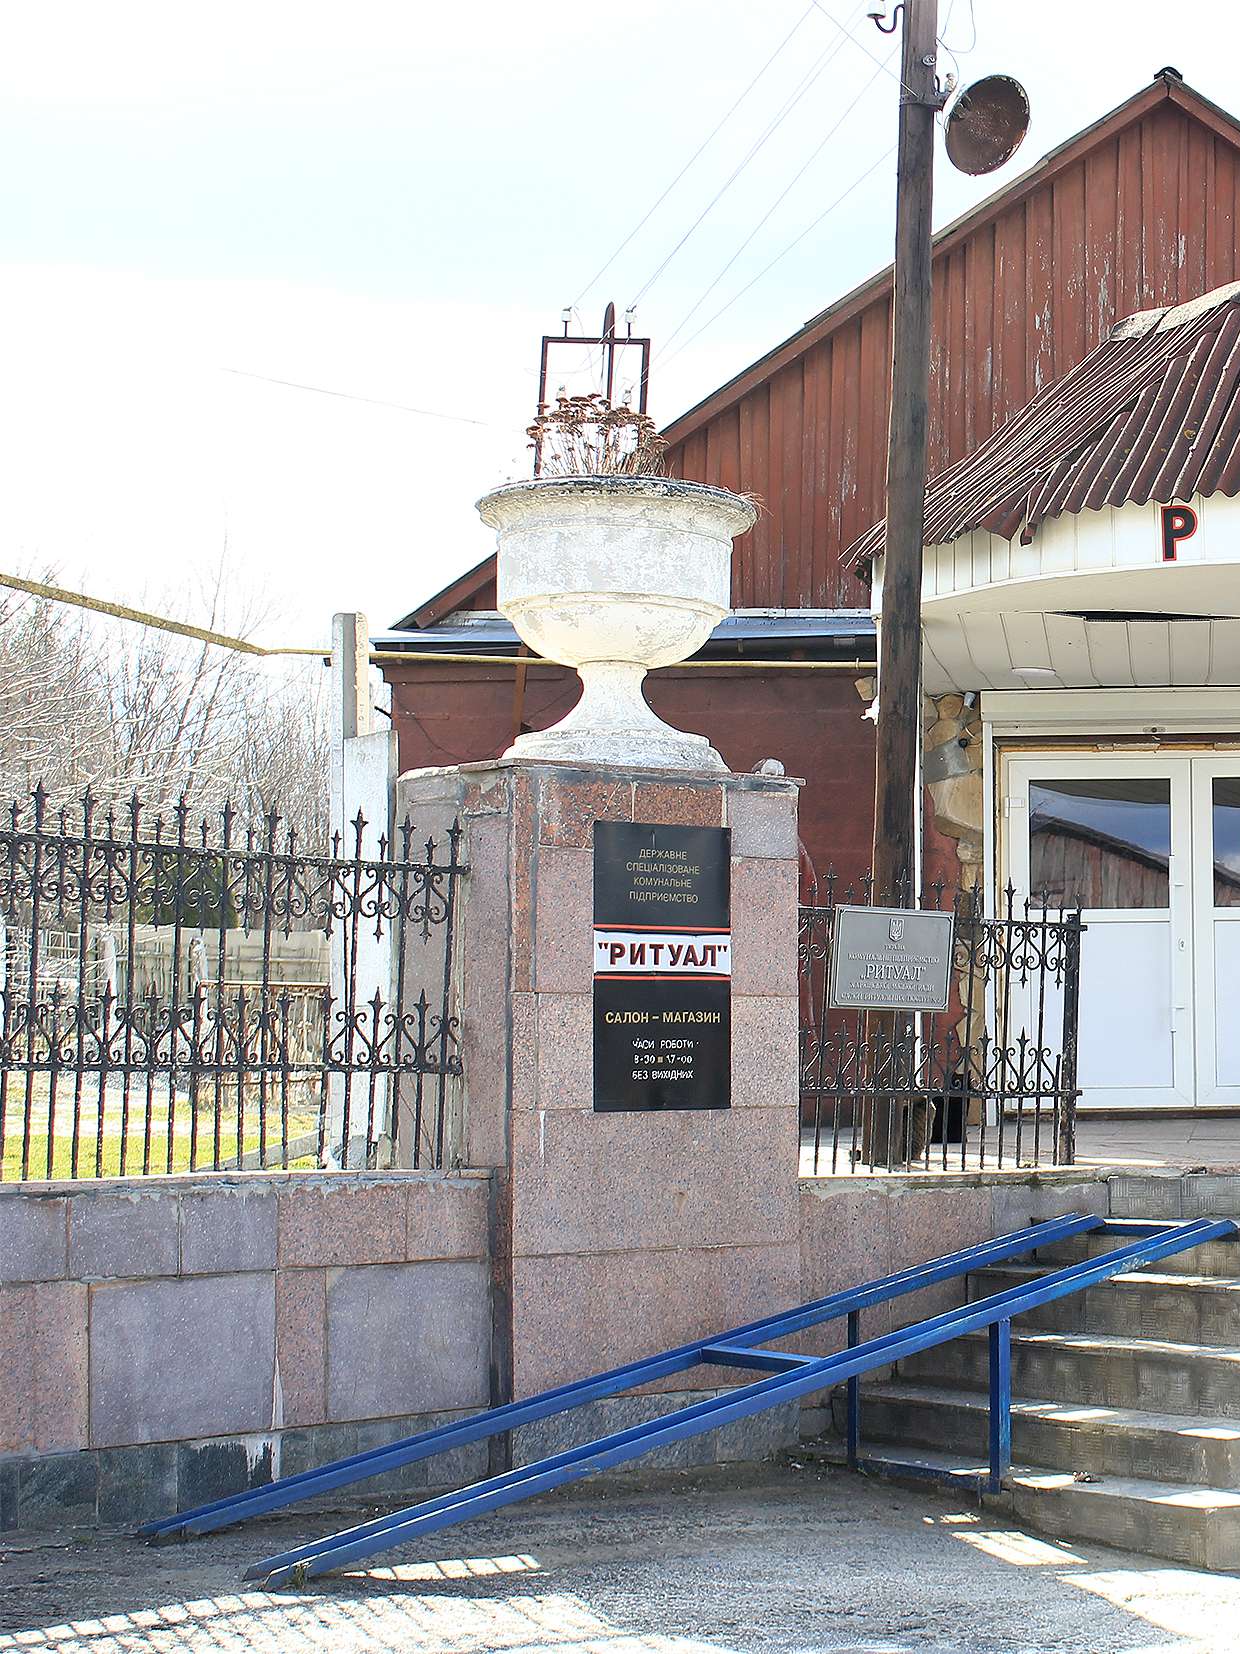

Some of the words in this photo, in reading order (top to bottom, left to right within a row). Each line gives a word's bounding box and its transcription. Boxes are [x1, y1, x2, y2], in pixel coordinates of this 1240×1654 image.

[638, 848, 688, 860] ДЕРЖАВНЕ
[626, 861, 700, 875] СПЕЦІАЛІЗОВАНЕ
[633, 876, 692, 888] КОМУНАЛЬНЕ
[629, 890, 699, 904] ПІДПРИЄМСТВО
[598, 942, 728, 967] "РИТУАЛ"
[605, 1011, 649, 1024] САЛОН
[662, 1011, 721, 1024] МАГАЗИН
[632, 1038, 655, 1050] ЧАСИ
[660, 1039, 694, 1049] РОБОТИ
[632, 1070, 649, 1080] БЕЗ
[651, 1069, 694, 1081] ВИХІДНИХ
